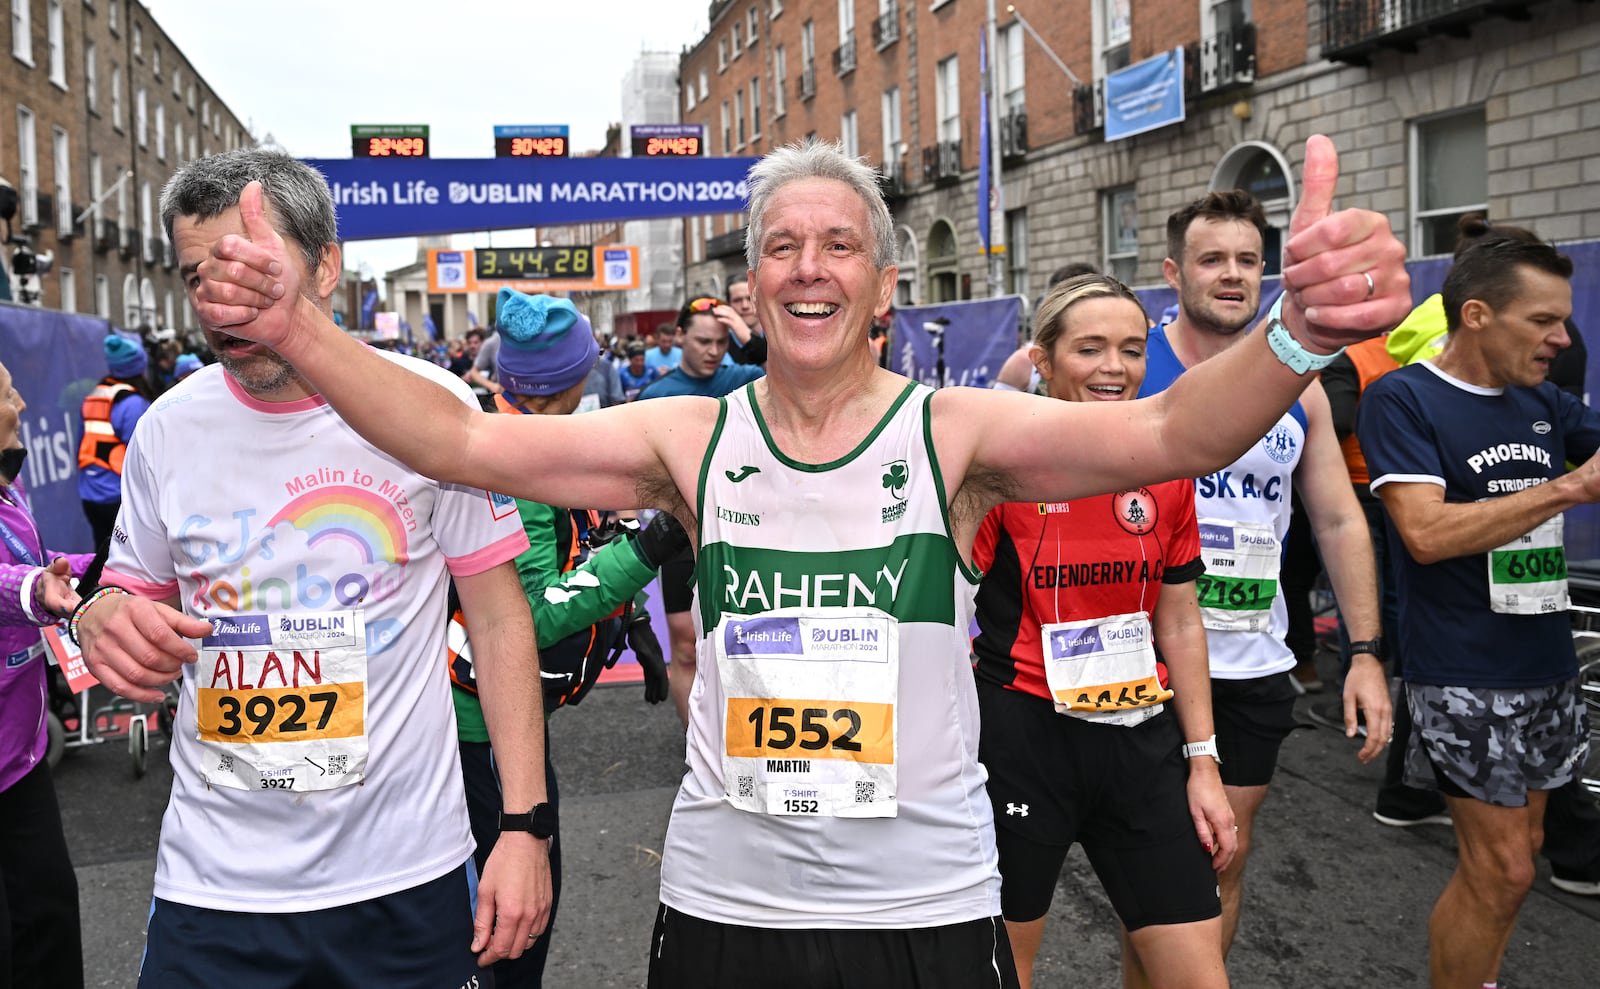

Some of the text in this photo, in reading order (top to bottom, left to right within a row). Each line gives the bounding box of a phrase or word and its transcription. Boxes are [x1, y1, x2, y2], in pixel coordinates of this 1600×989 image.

[334, 181, 388, 205] Irish
[393, 180, 440, 205] Life
[449, 182, 543, 204] DUBLIN
[1467, 443, 1553, 474] PHOENIX
[1194, 472, 1237, 499] SK
[285, 467, 418, 533] Malin to Mizen
[717, 506, 760, 526] LEYDENS
[1216, 533, 1229, 543] Life
[1241, 534, 1276, 545] DUBLIN
[1212, 558, 1235, 567] JUSTIN
[1508, 552, 1564, 579] 6062
[1034, 561, 1136, 589] EDENDERRY
[190, 563, 406, 612] Rainbow
[723, 559, 908, 610] RAHENY
[221, 623, 260, 634] Irish Life
[280, 617, 344, 631] DUBLIN
[746, 631, 792, 642] Irish Life
[812, 628, 878, 642] DUBLIN
[1084, 635, 1096, 645] Life
[1107, 627, 1144, 640] DUBLIN
[811, 643, 858, 651] MARATHON
[67, 670, 80, 680] ALL
[211, 650, 322, 691] ALAN
[218, 691, 338, 735] 3927
[748, 706, 862, 752] 1552
[259, 768, 293, 777] T-SHIRT
[767, 760, 810, 773] MARTIN
[260, 778, 295, 789] 3927
[784, 789, 818, 798] T-SHIRT
[784, 800, 818, 813] 1552
